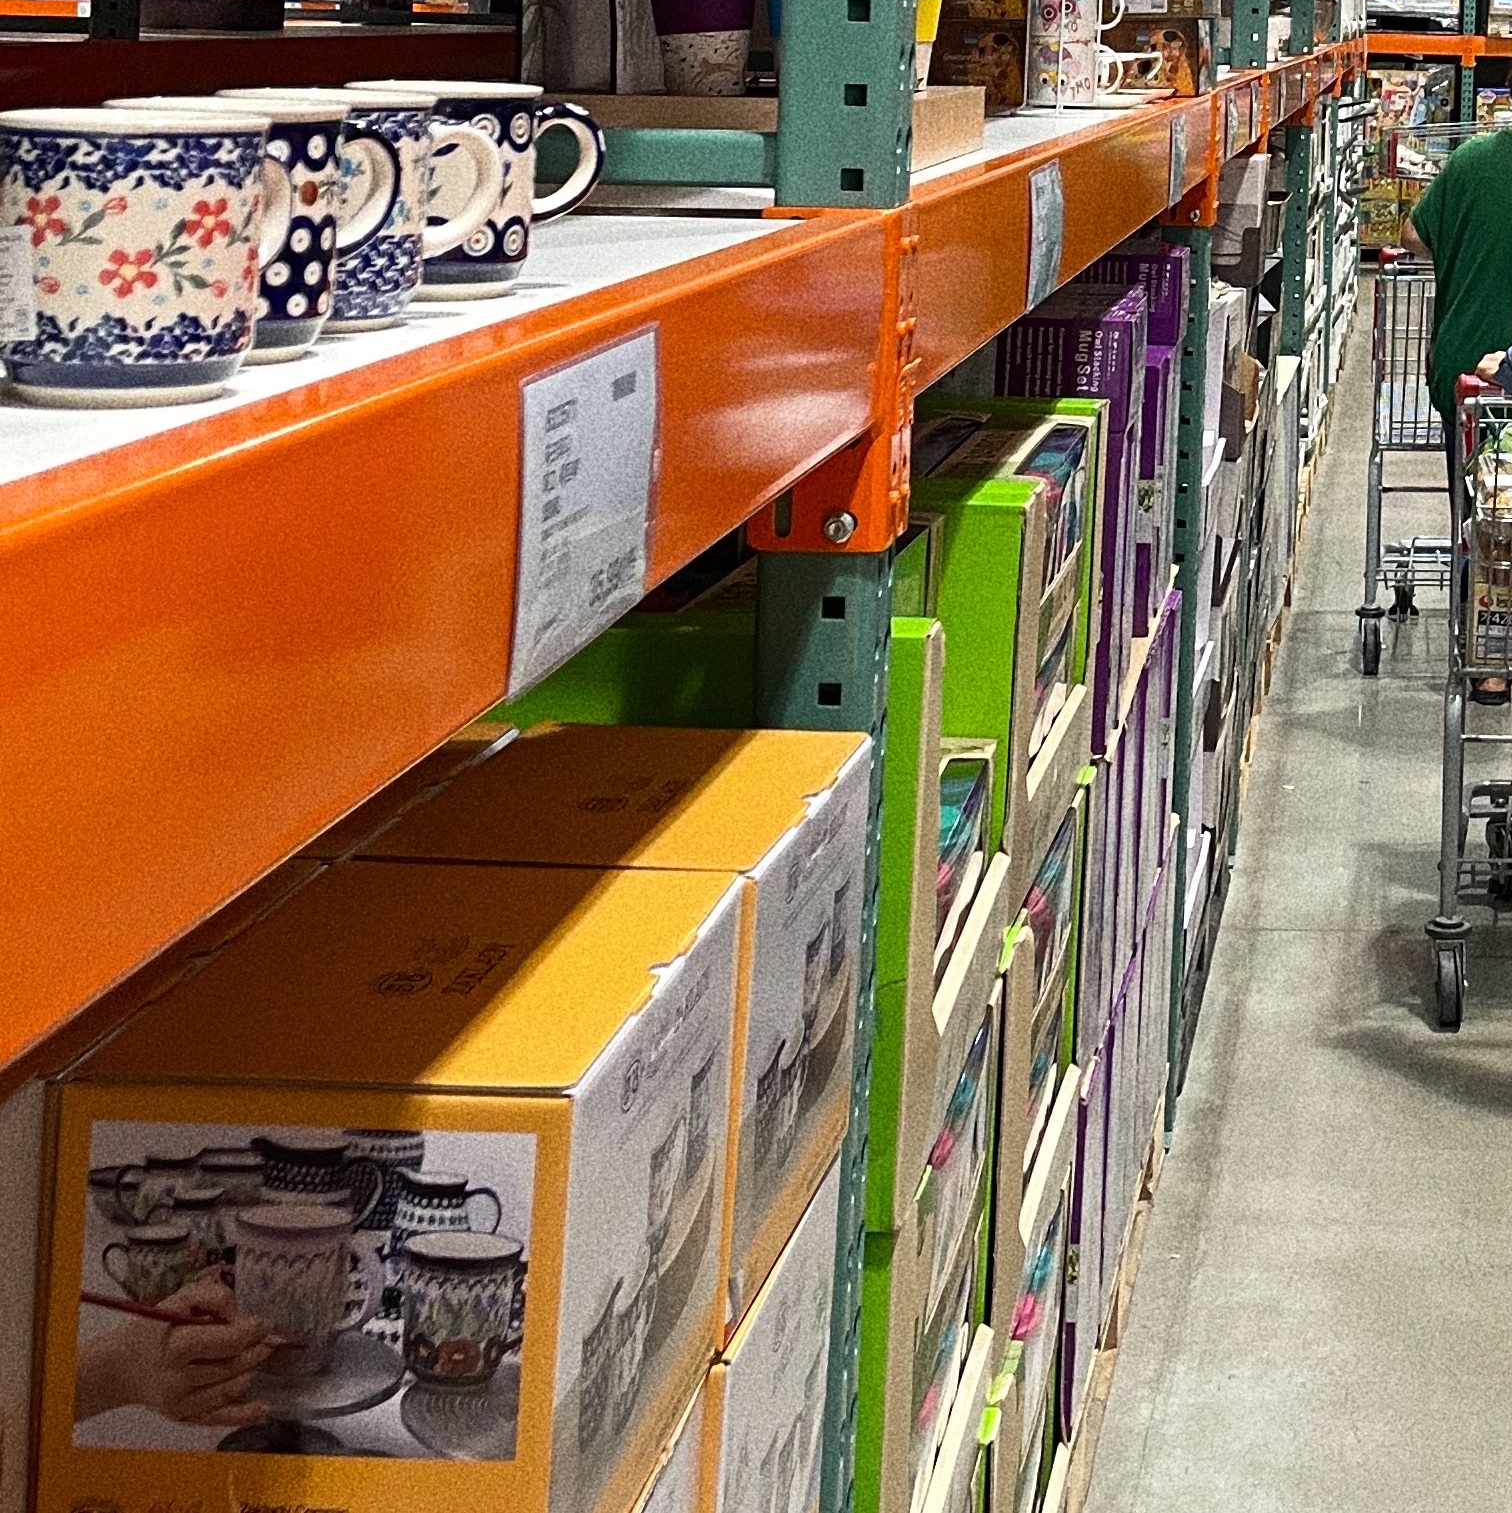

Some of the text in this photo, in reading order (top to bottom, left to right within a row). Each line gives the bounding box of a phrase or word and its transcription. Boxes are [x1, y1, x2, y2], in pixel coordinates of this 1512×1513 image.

[1075, 330, 1093, 392] Mug Set
[1090, 330, 1104, 392] Owl Stacking
